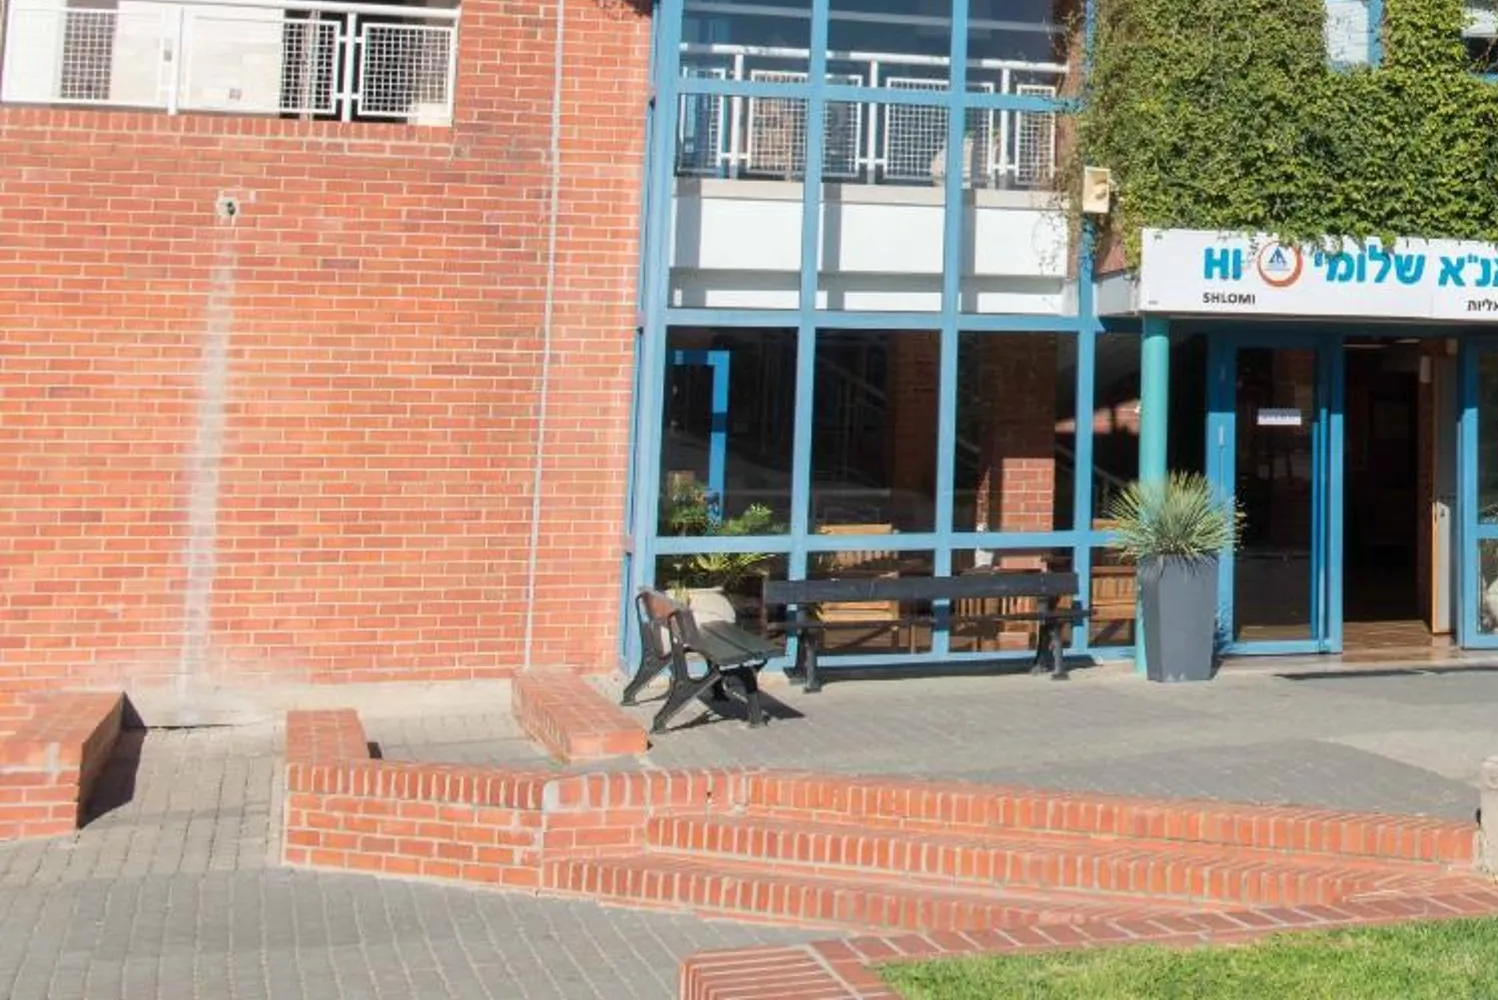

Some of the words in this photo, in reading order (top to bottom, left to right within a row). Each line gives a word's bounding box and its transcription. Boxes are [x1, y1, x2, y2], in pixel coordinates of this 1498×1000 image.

[1204, 248, 1242, 280] HI
[1313, 244, 1426, 284] שלומי
[1203, 292, 1256, 304] SHLOMI
